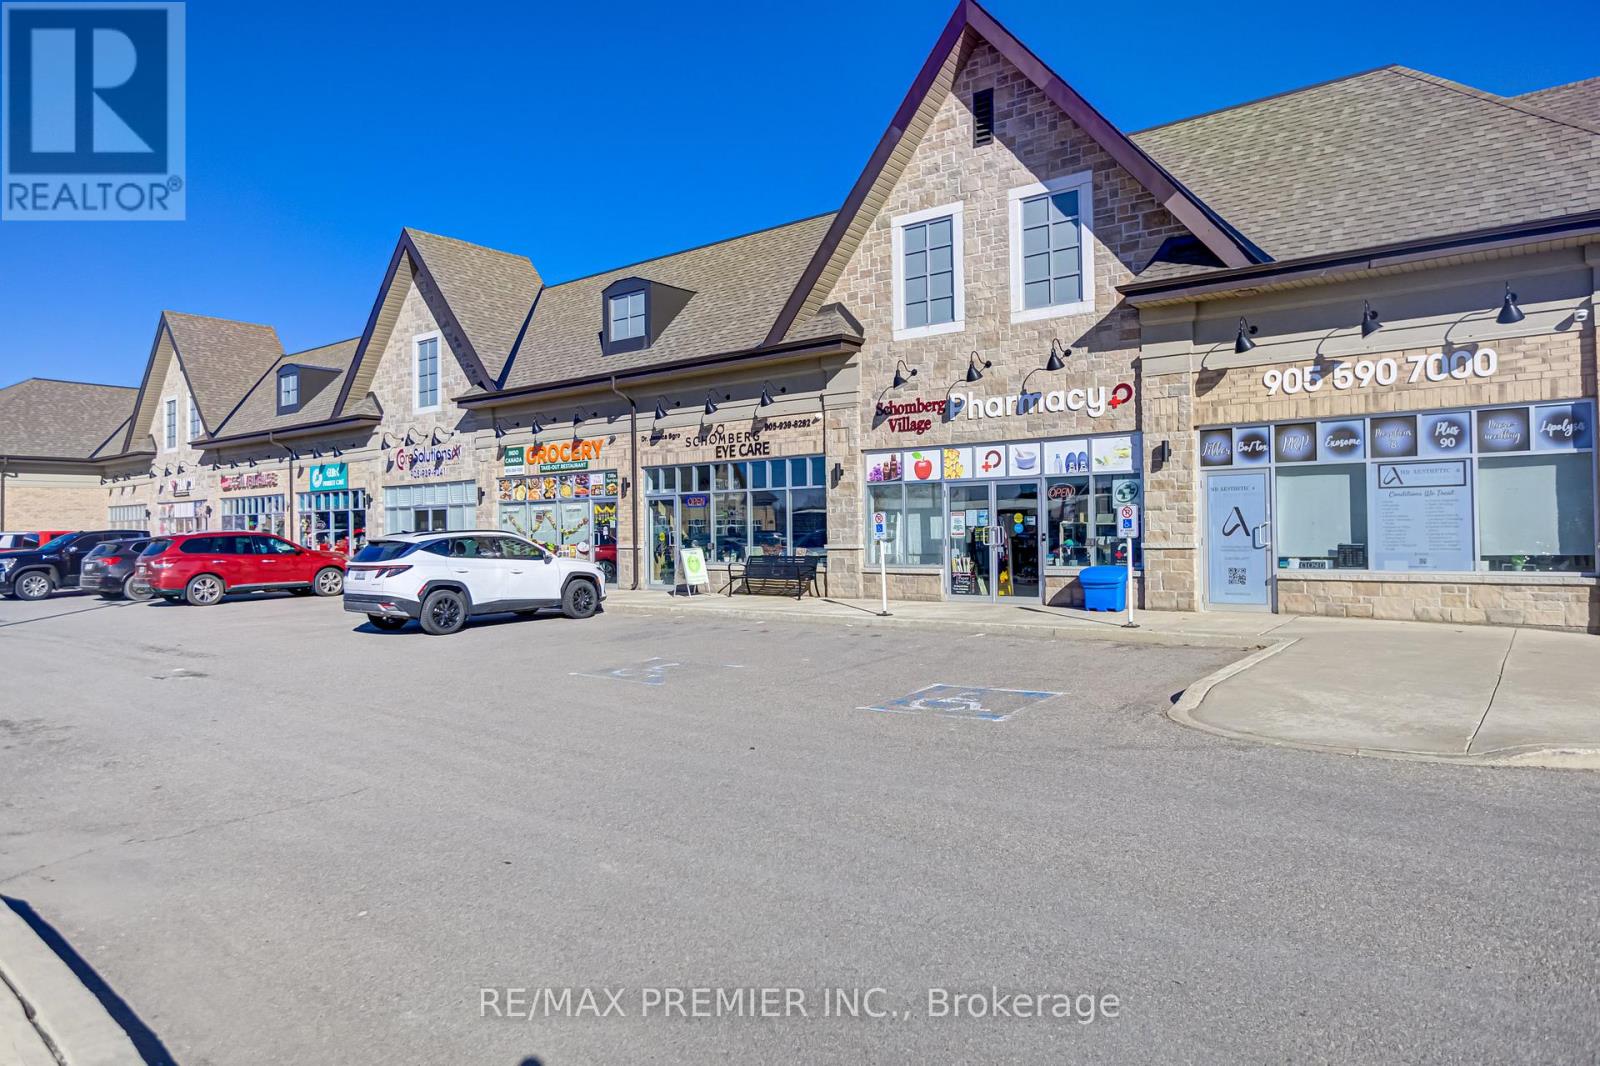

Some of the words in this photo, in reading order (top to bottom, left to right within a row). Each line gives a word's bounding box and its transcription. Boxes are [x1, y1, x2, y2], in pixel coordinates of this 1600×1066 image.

[1263, 366, 1323, 396] 905
[1333, 358, 1398, 389] 590
[1406, 348, 1498, 384] 7000
[876, 397, 946, 417] Schomberg
[949, 386, 1105, 421] Pharmacy
[888, 417, 932, 435] Village
[1435, 421, 1461, 437] Plus
[685, 430, 760, 448] SCHOMBERG
[1324, 435, 1361, 448] Exosome
[1439, 437, 1456, 448] 90
[525, 440, 605, 465] GROCERY
[715, 444, 736, 459] EYE
[739, 441, 770, 456] CARE
[1049, 487, 1073, 498] OPEN
[688, 497, 705, 507] OPEN
